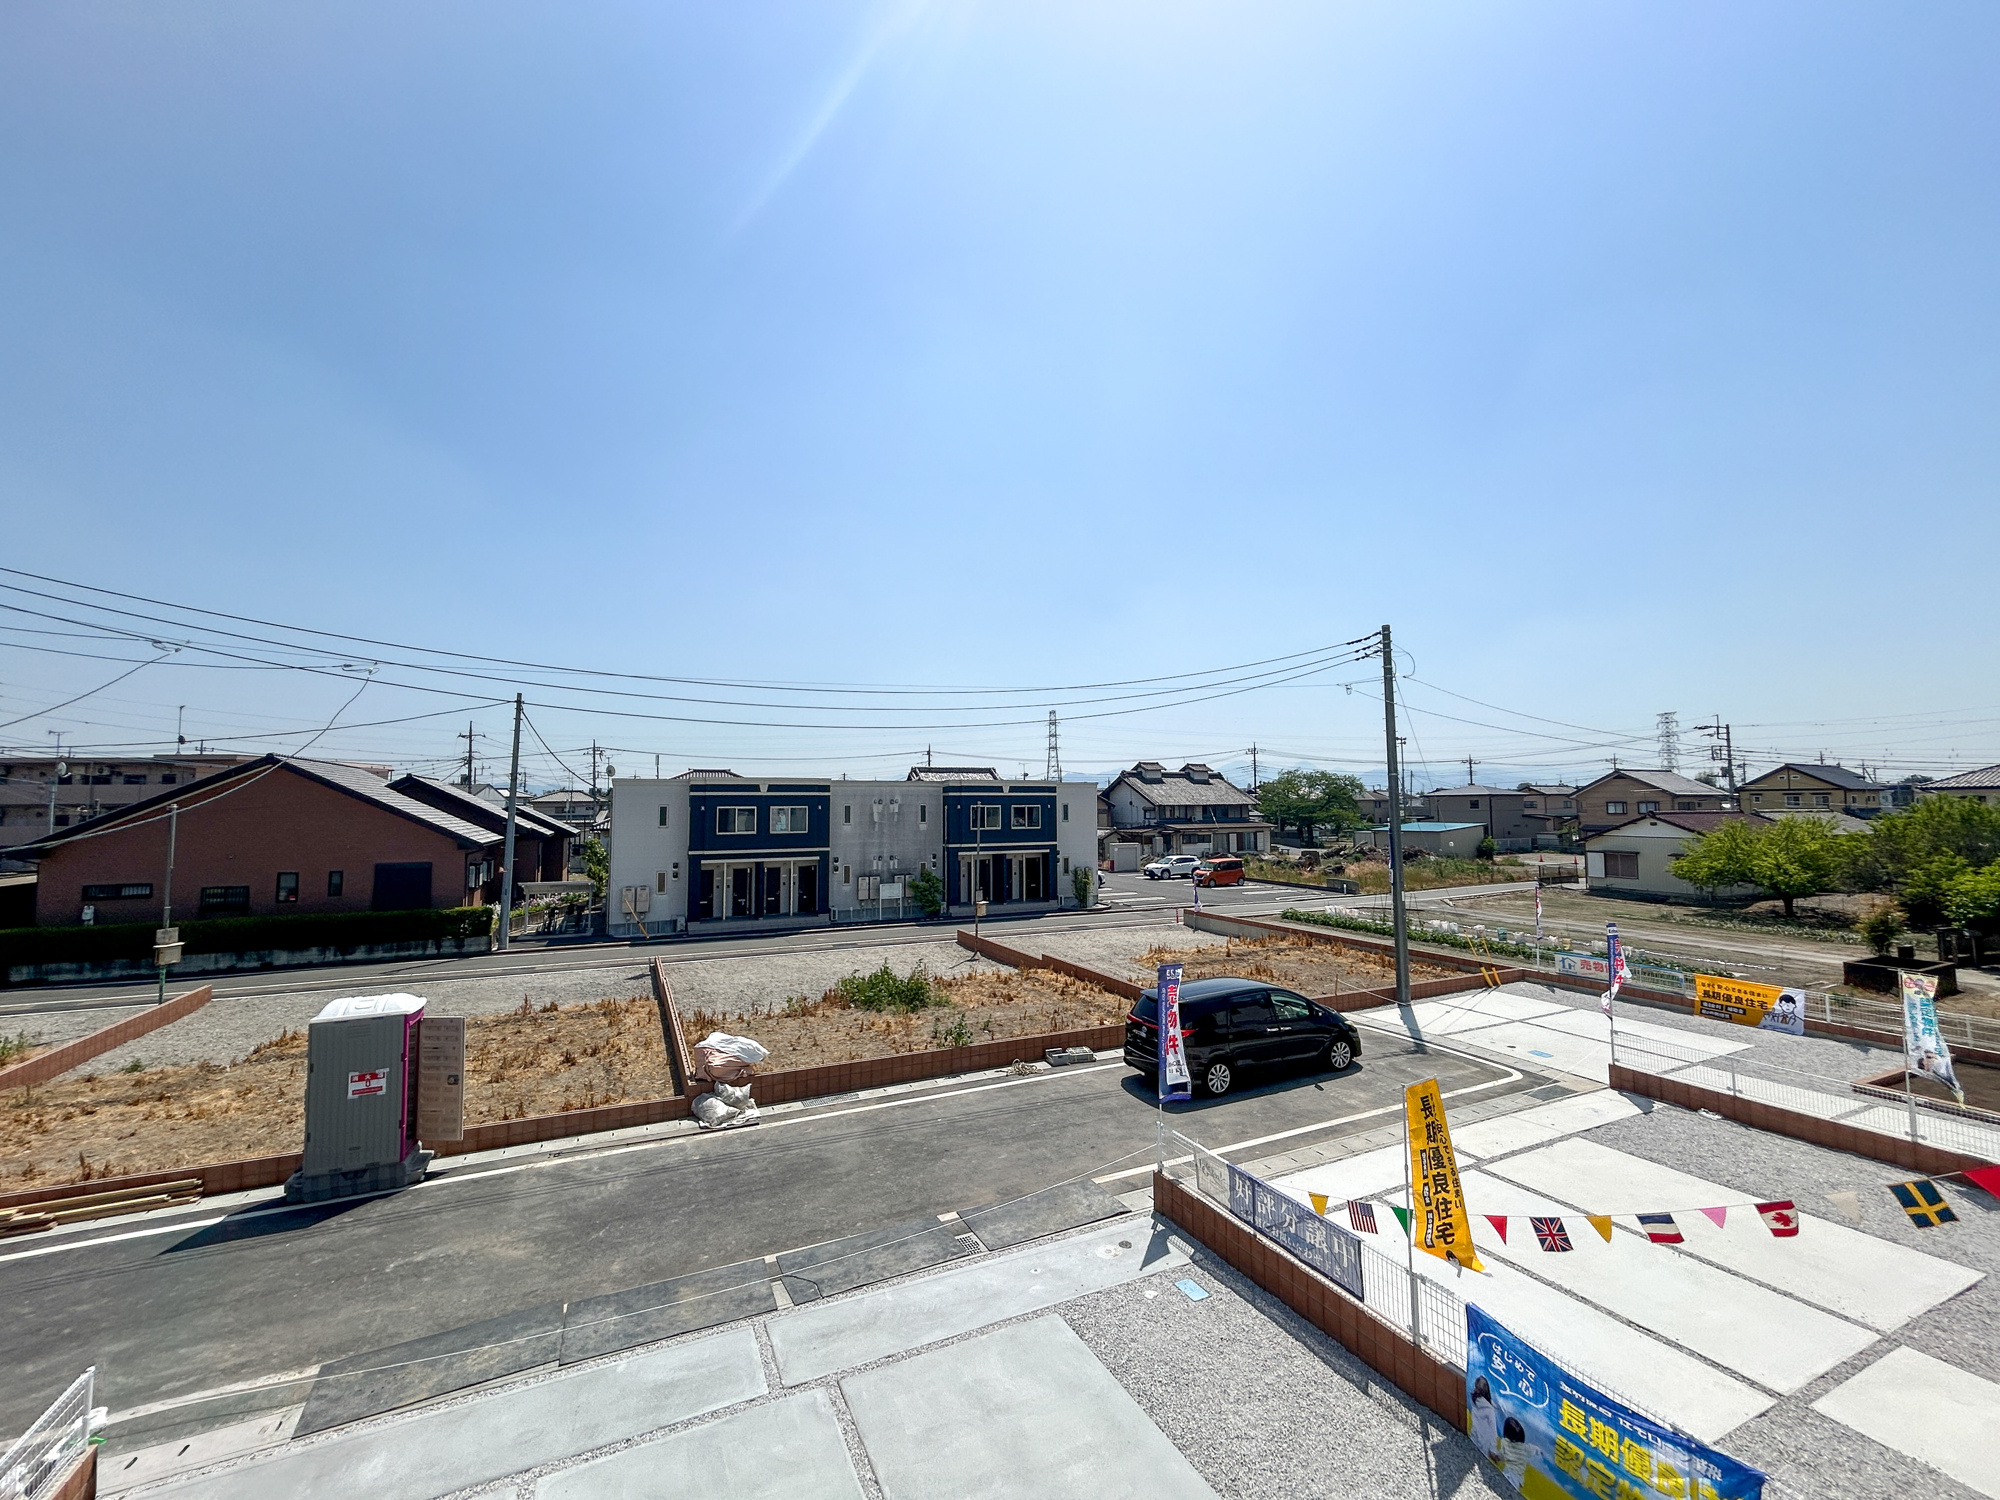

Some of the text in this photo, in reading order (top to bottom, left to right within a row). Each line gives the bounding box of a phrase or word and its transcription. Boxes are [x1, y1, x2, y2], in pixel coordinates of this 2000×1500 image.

[1702, 989, 1768, 1010] 長期優良住宅
[1420, 1095, 1455, 1245] 長期優良住宅
[1235, 1173, 1355, 1268] 好評分譲中
